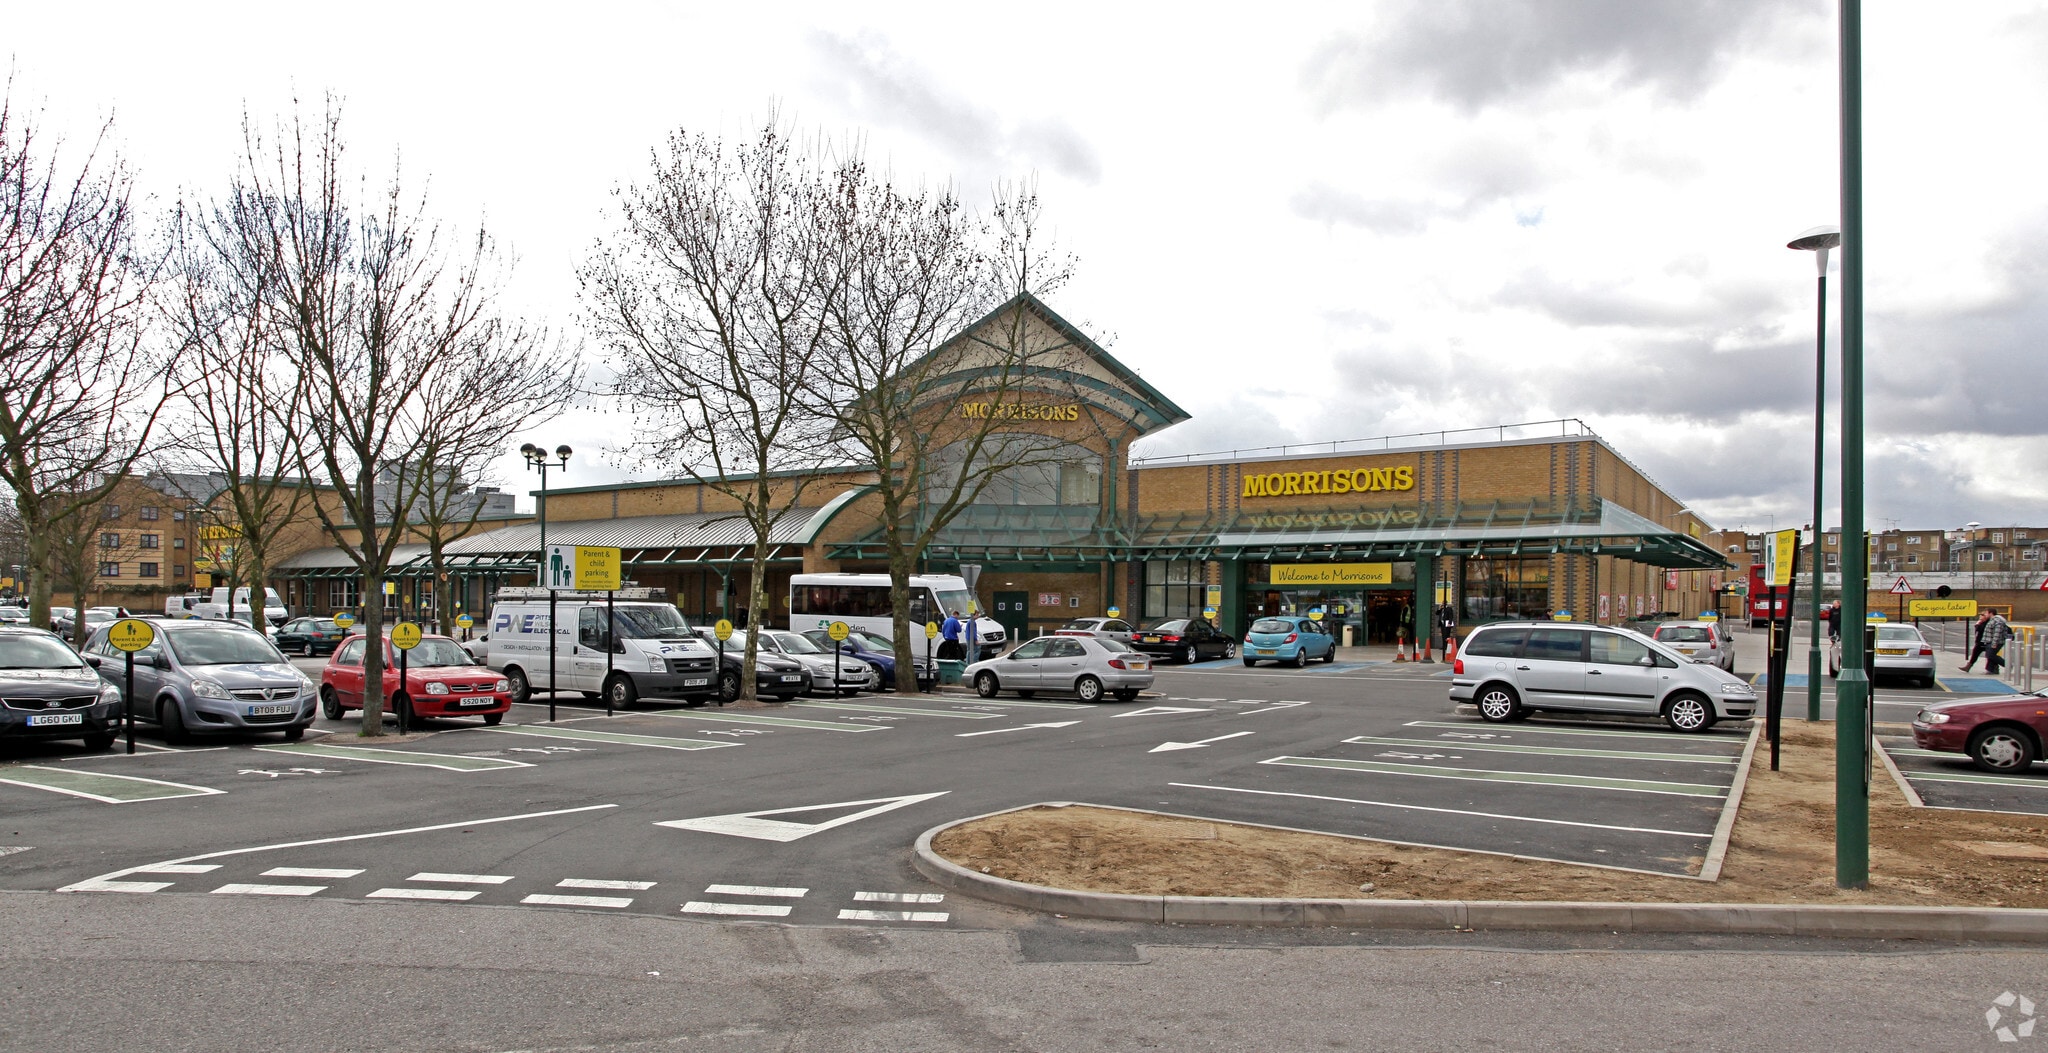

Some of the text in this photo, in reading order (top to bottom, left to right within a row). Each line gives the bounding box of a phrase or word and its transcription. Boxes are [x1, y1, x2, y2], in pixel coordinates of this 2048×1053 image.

[1242, 466, 1414, 497] MORRISONS
[585, 570, 609, 578] parking
[1278, 568, 1383, 581] Welcome to Morrisons
[254, 706, 275, 714] BT08
[33, 714, 81, 725] LG60 GKU
